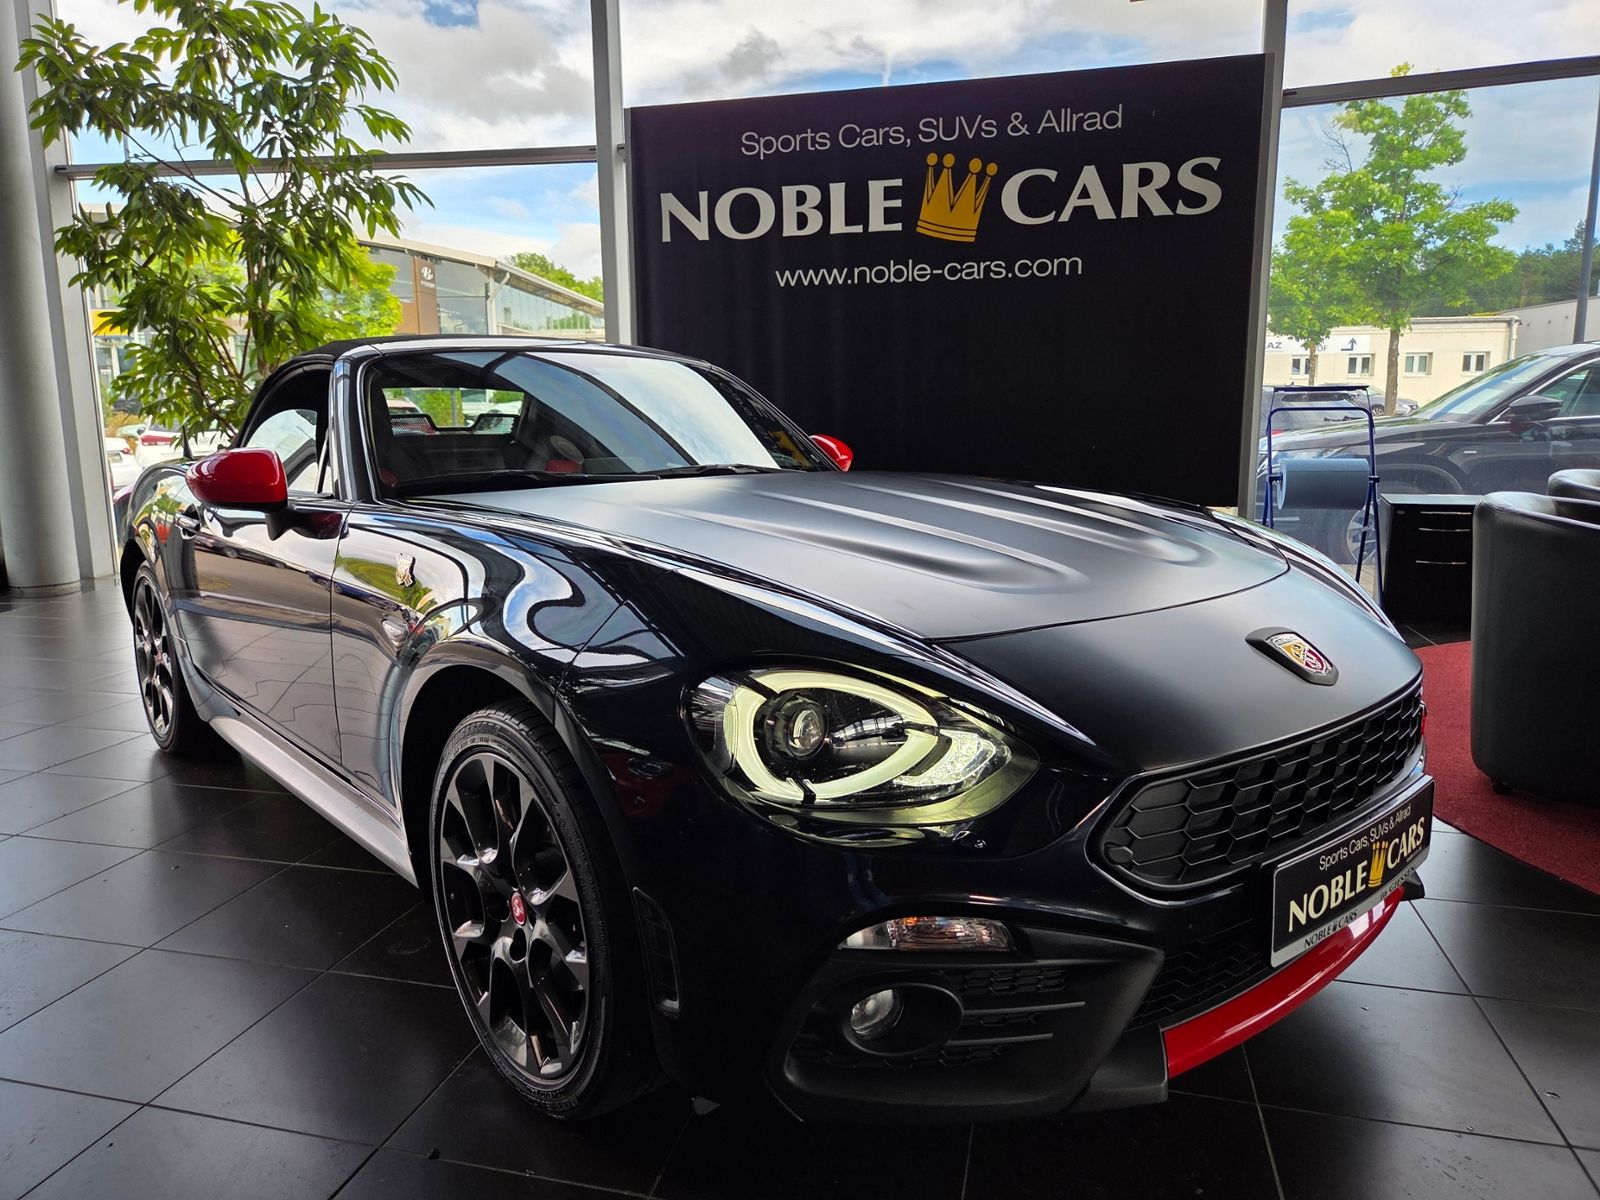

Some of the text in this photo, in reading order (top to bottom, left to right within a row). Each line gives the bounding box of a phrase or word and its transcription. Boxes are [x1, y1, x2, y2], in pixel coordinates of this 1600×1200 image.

[741, 104, 1123, 160] Sports Cars, SUVs & Allrad
[660, 156, 1223, 243] NOBLE CARS
[775, 255, 1083, 288] www.noble-cars.com
[1319, 847, 1348, 871] Sports
[1349, 836, 1369, 854] Cars,
[1370, 821, 1389, 843] SUVs
[1395, 803, 1411, 826] Allrad
[1288, 816, 1425, 933] NOBLE CARS
[1304, 925, 1331, 949] NOBLE
[1338, 908, 1358, 929] CARS
